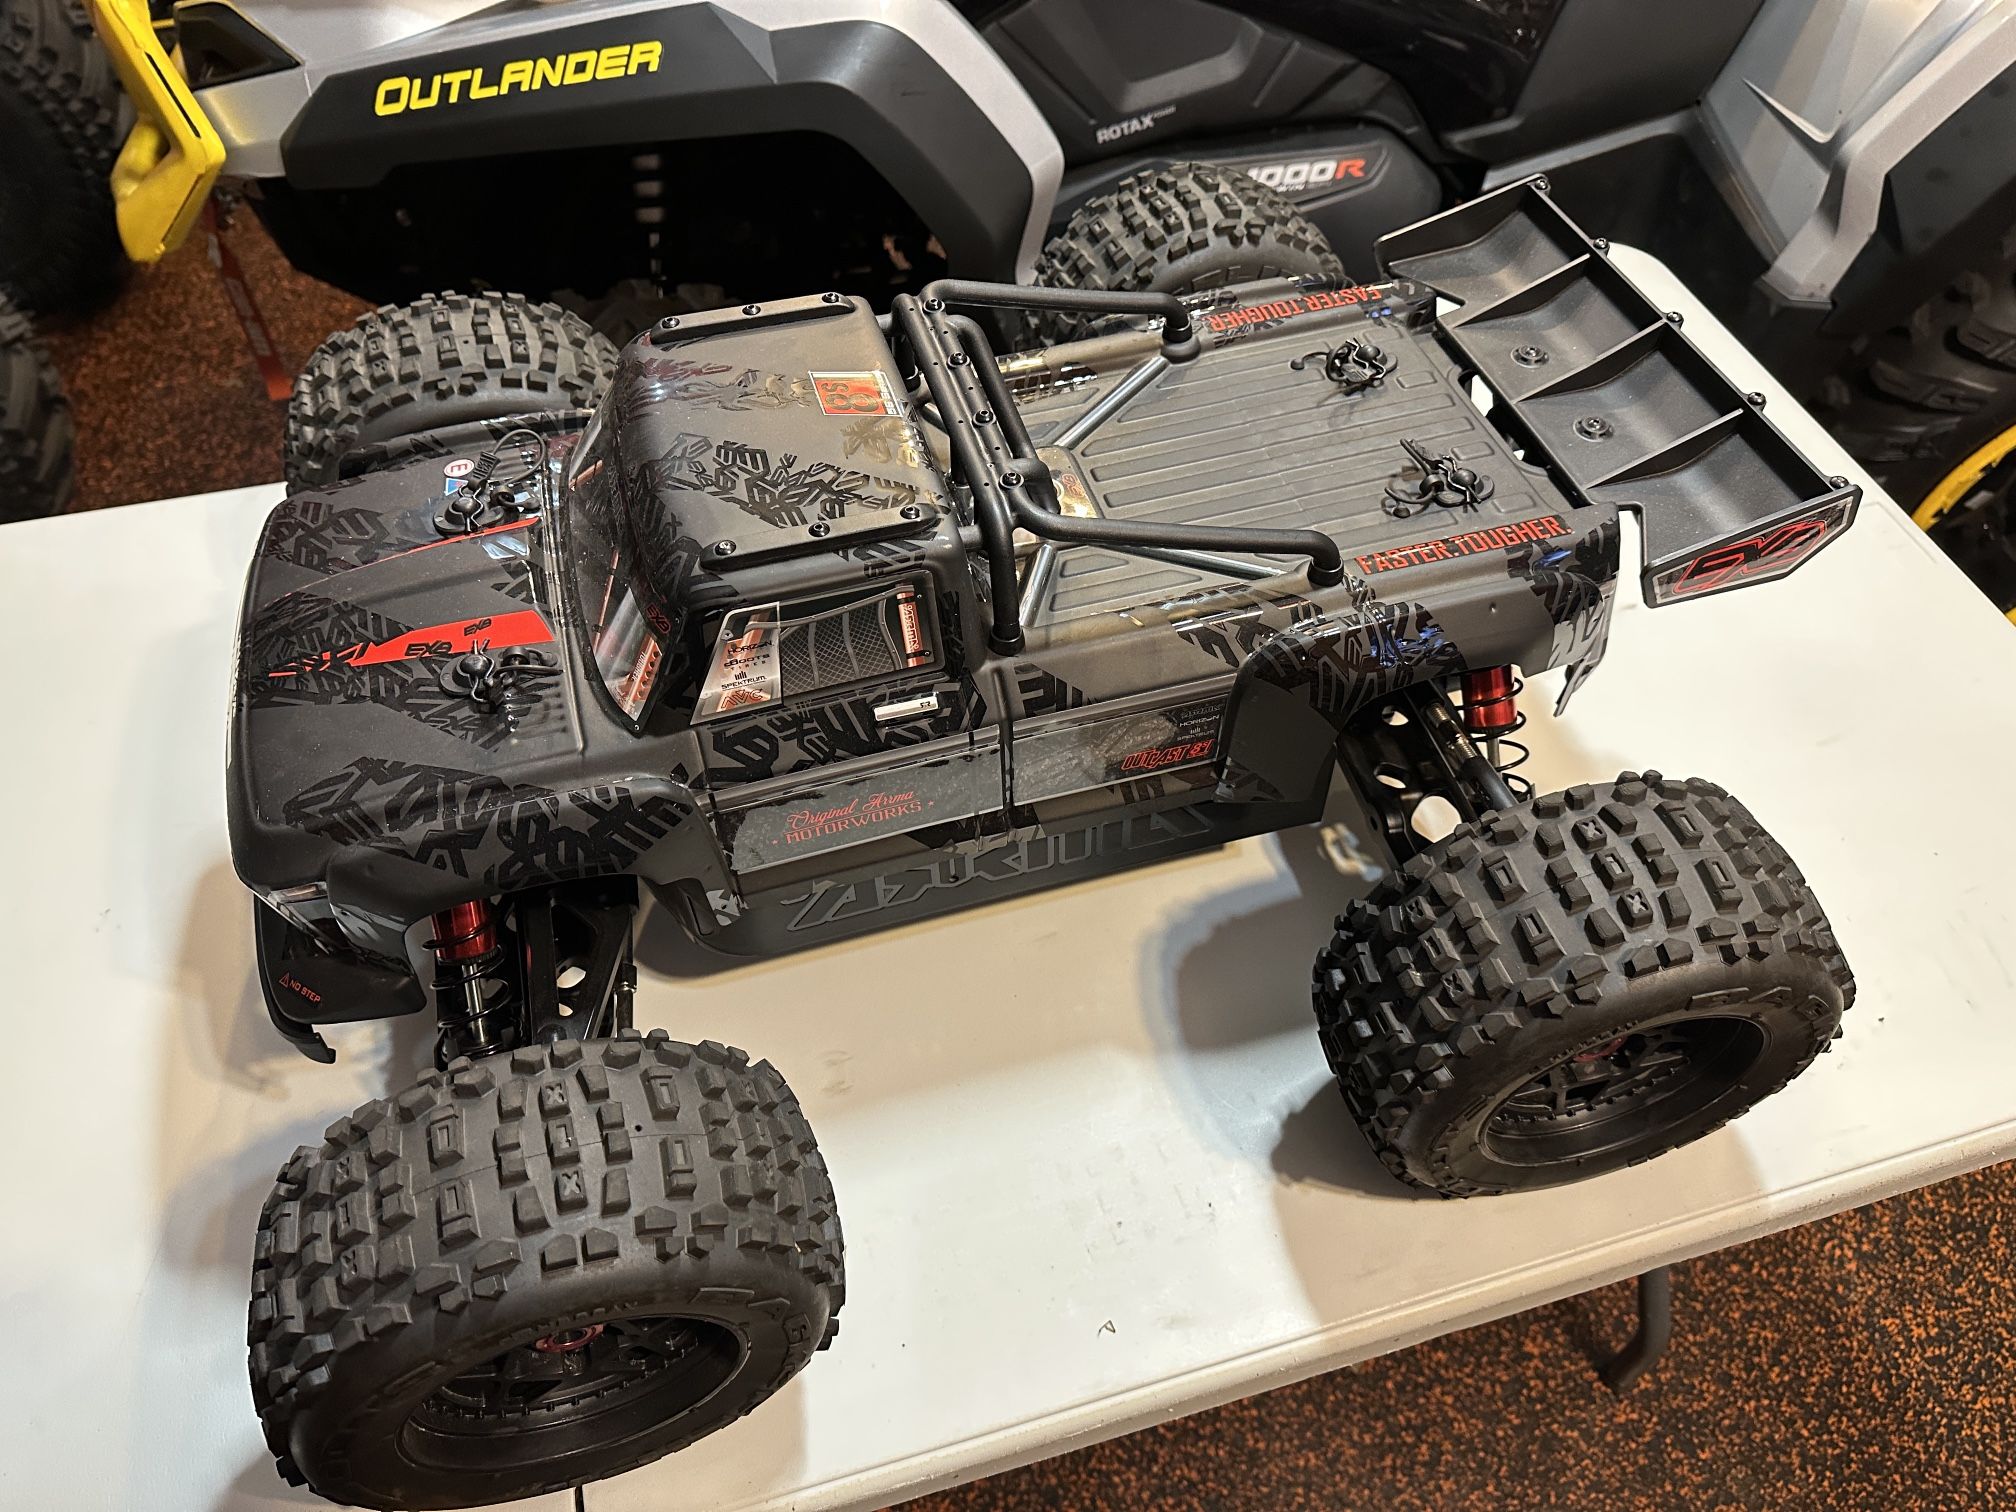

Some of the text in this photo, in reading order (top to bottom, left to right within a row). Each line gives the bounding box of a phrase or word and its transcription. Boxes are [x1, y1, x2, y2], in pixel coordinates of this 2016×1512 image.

[374, 40, 663, 117] OUTLANDER
[1096, 112, 1155, 144] ROTAX
[1121, 744, 1192, 771] OUTCAST
[784, 802, 923, 844] MOTORWORKS
[786, 790, 915, 831] Original Arrma
[290, 979, 321, 1003] NO STEP
